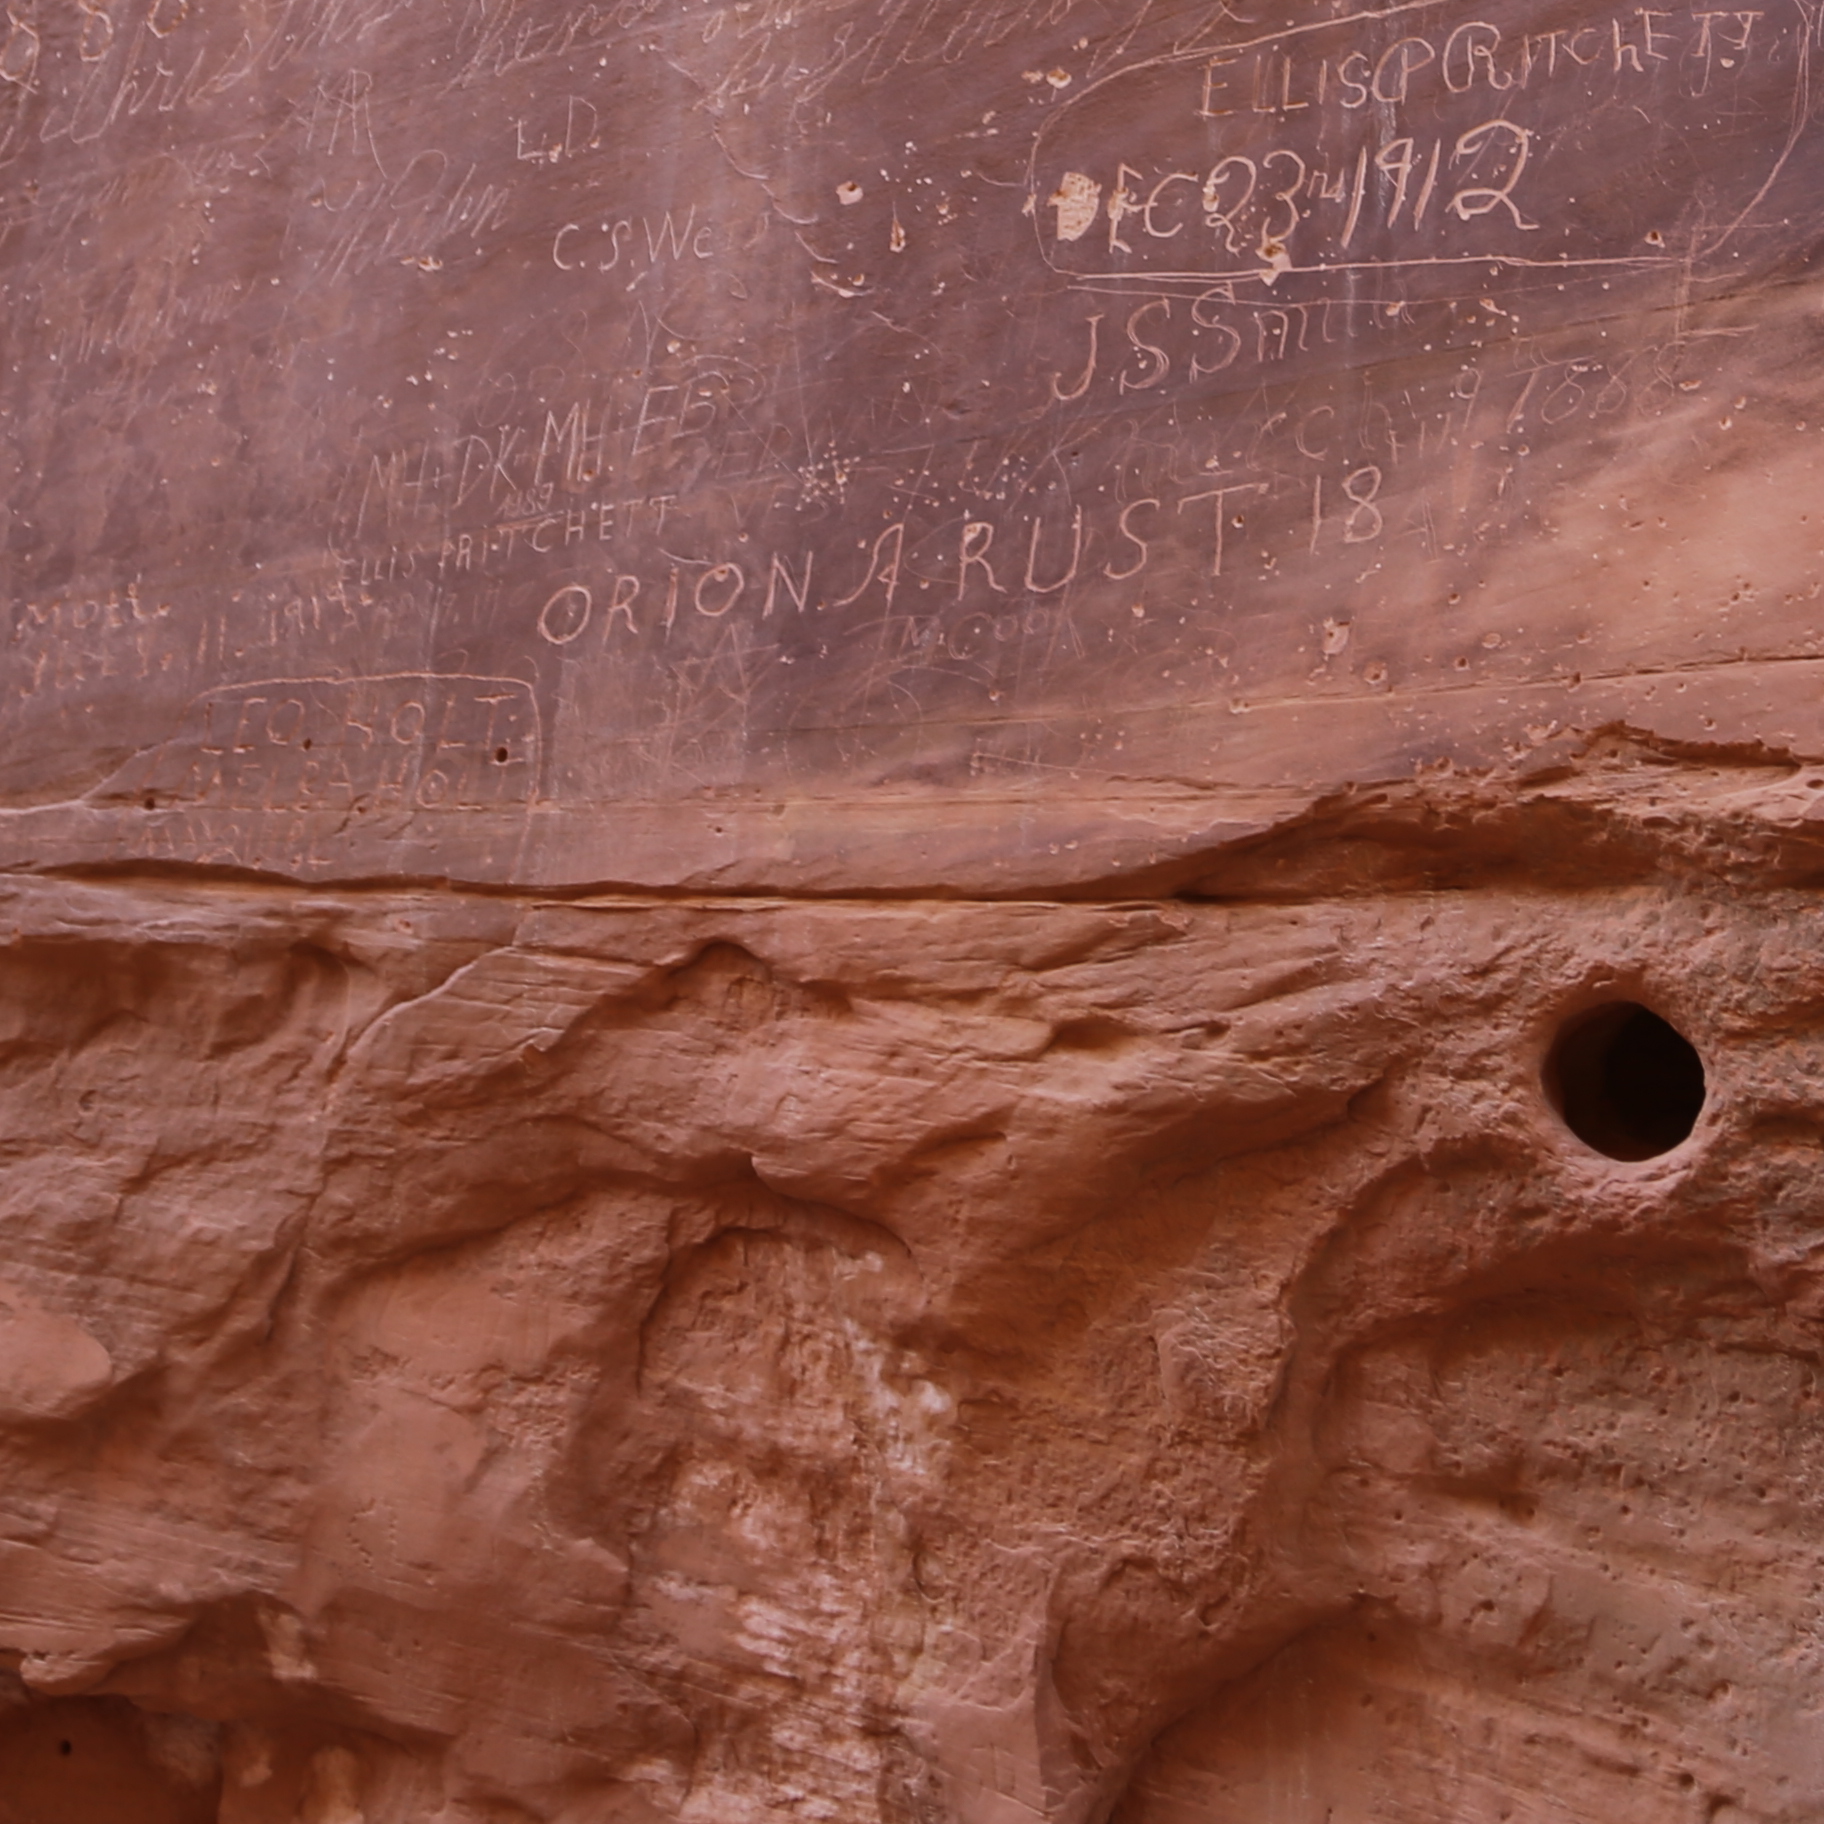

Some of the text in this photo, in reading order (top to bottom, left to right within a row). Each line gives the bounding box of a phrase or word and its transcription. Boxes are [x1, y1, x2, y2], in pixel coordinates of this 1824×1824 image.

[1194, 54, 1374, 118] ELLIS
[1341, 120, 1540, 250] 1912
[536, 548, 816, 646] ORION
[956, 480, 1272, 600] RUST
